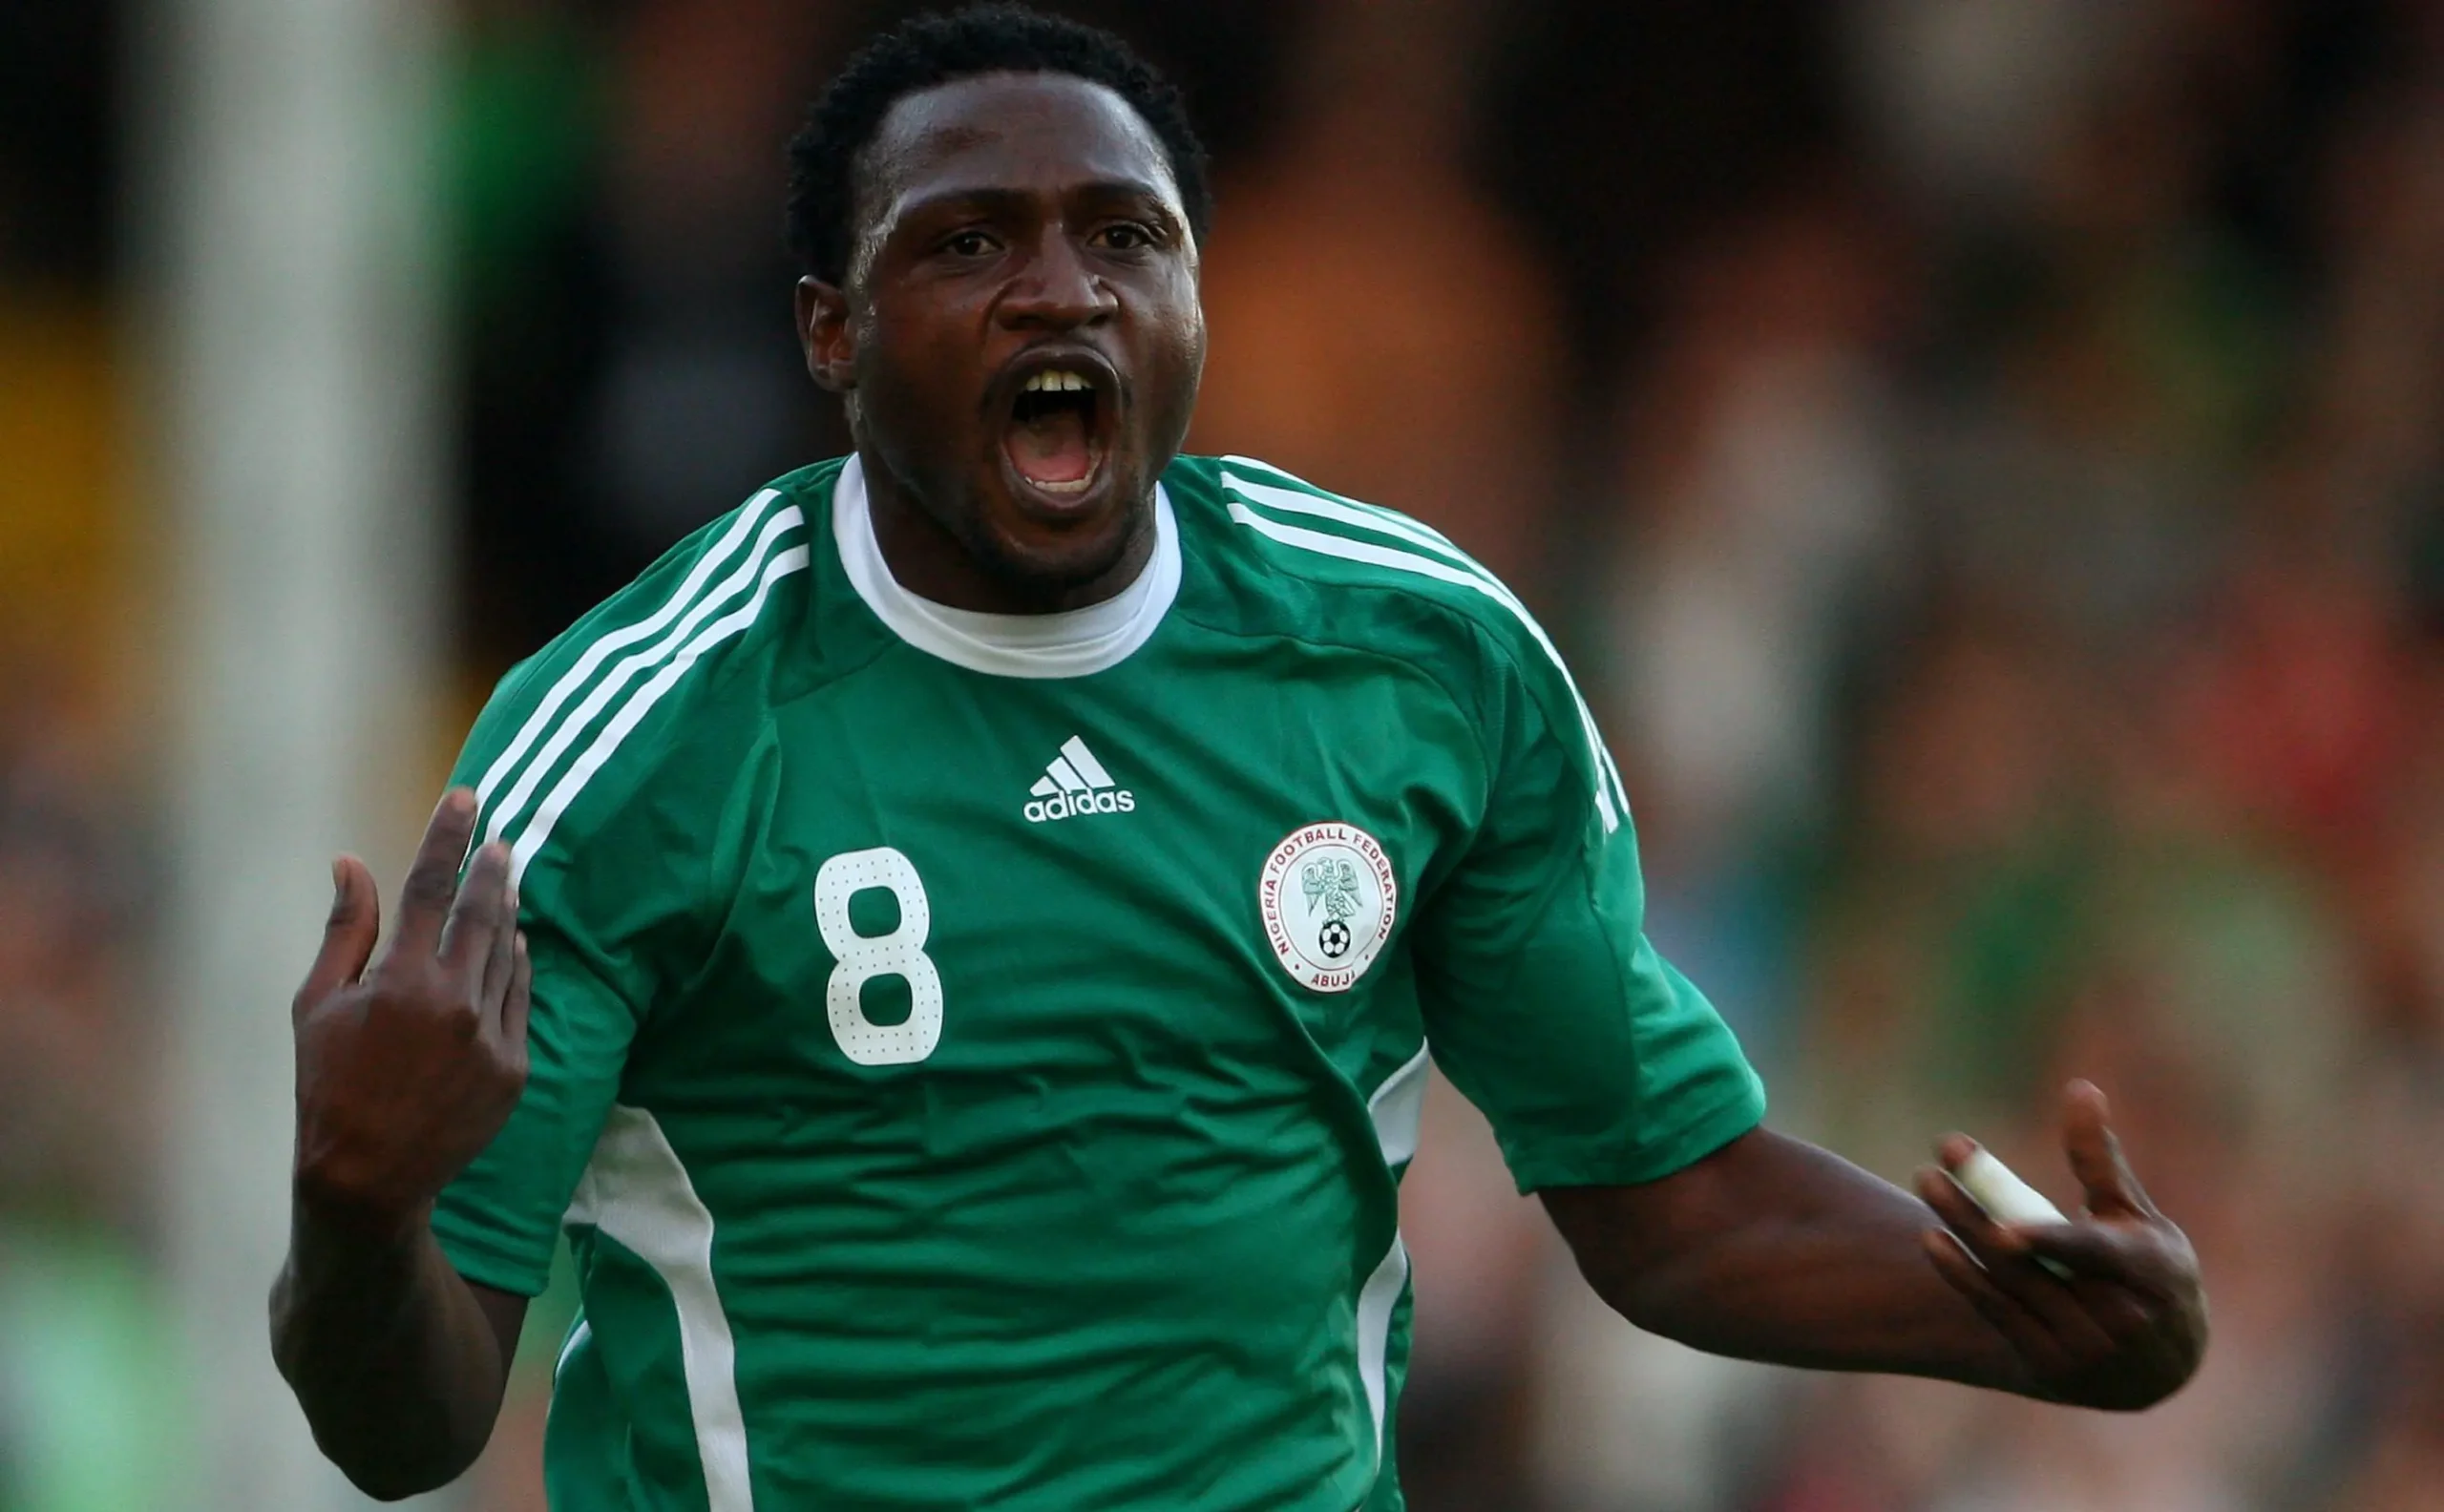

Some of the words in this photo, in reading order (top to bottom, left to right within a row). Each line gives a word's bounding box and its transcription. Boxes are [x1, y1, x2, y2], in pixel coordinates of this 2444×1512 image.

[1023, 788, 1136, 823] adidas
[1269, 827, 1347, 875] FOOTBALL
[1352, 833, 1395, 940] FEDERATION
[813, 846, 944, 1066] 8
[1264, 878, 1290, 956] NIGERIA
